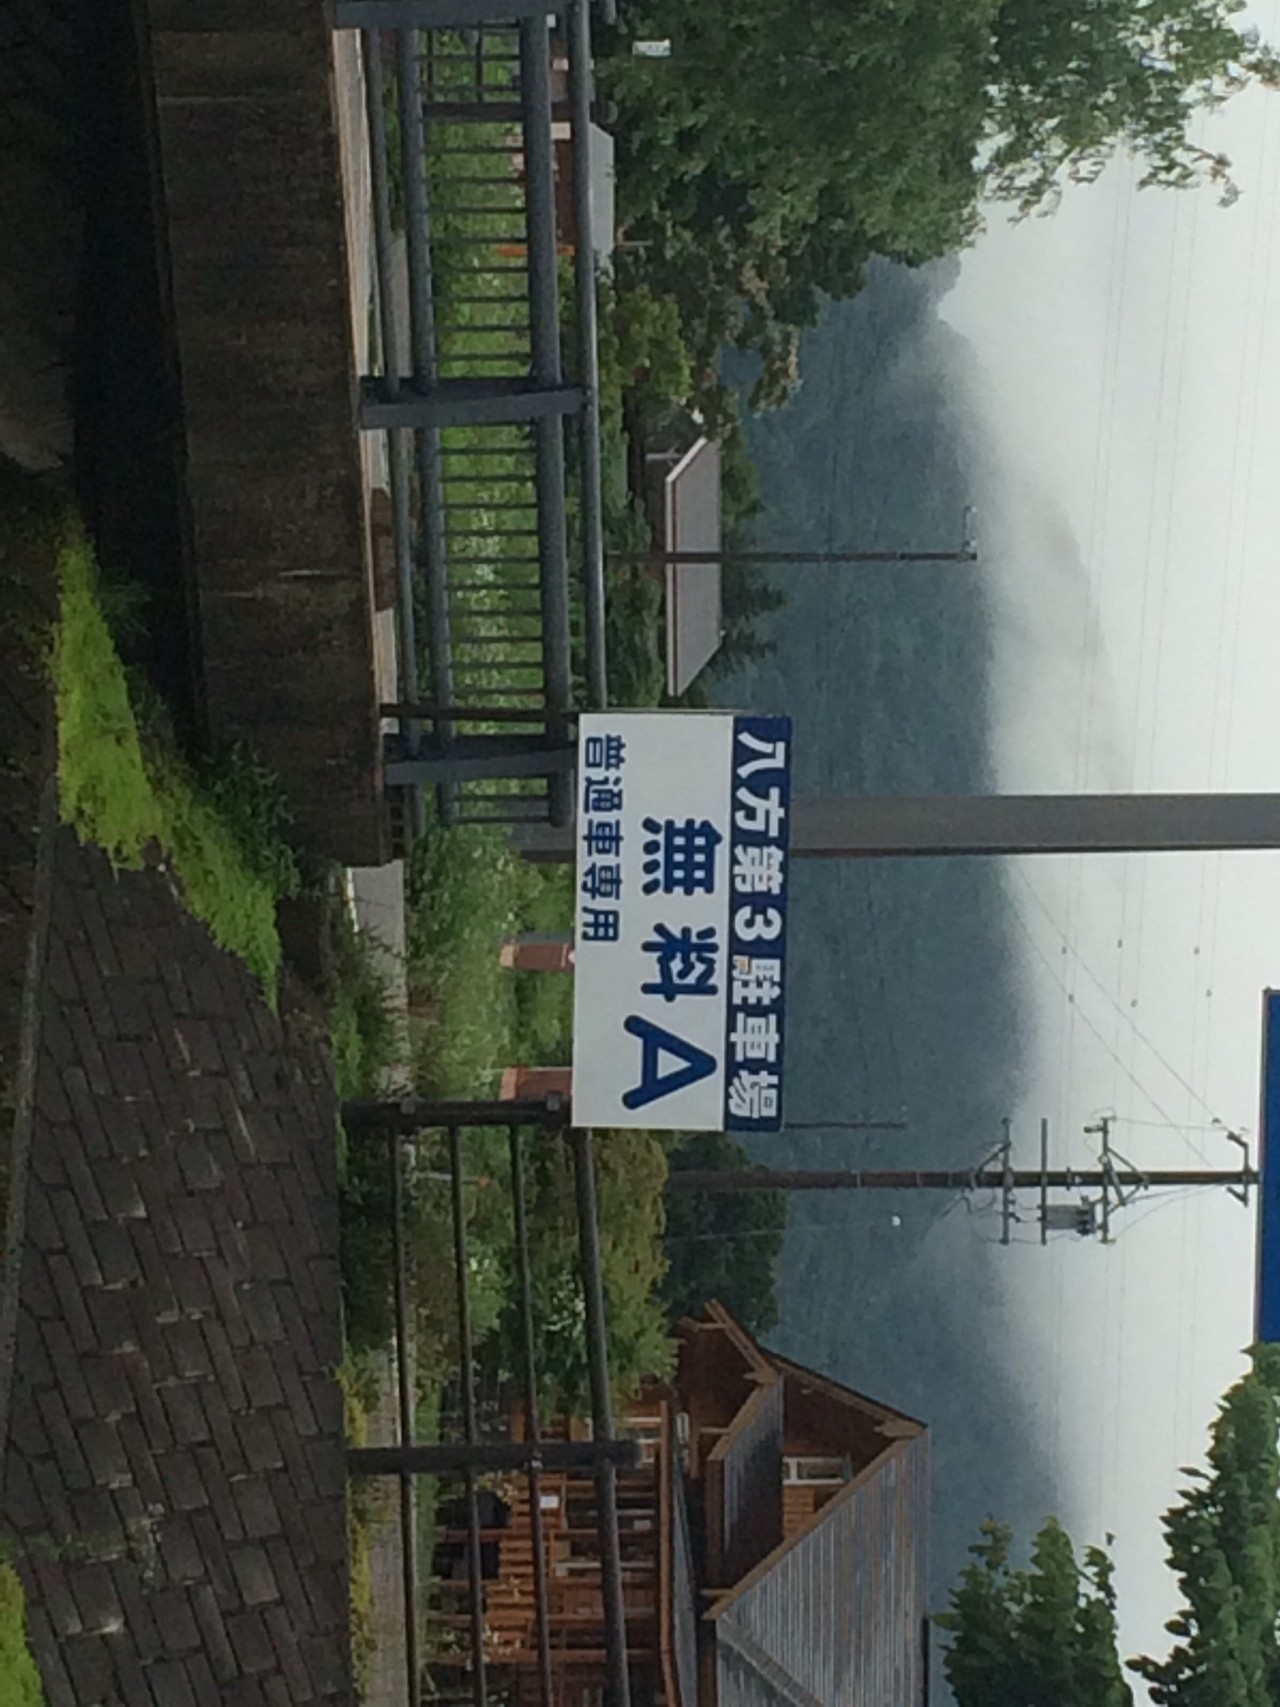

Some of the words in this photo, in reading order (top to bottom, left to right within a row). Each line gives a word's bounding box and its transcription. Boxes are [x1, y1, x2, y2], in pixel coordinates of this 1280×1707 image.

[581, 734, 625, 942] 普通車専用
[728, 730, 786, 1119] 八方第3駐車場
